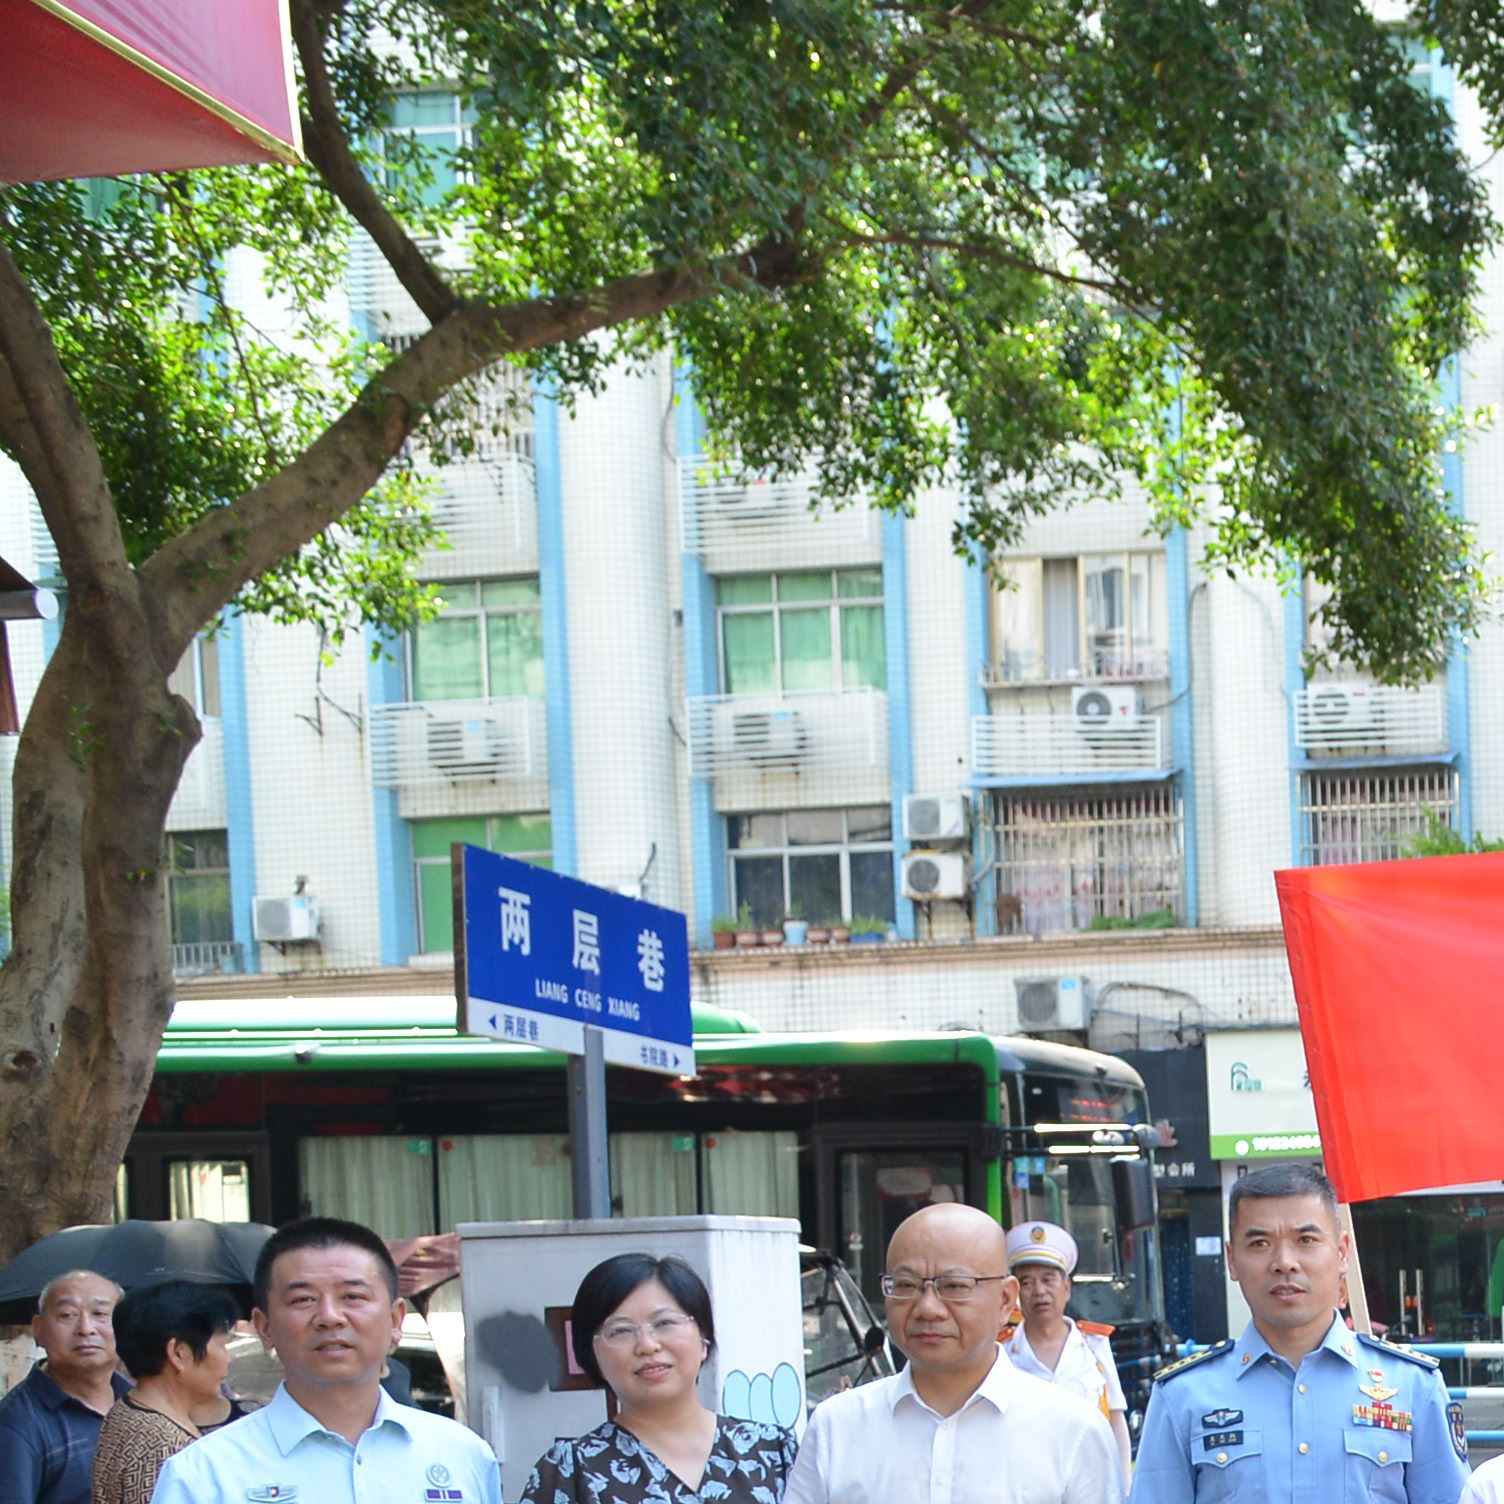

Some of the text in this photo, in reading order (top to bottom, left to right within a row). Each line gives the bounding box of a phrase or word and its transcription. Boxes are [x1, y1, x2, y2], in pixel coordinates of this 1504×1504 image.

[499, 885, 666, 993] 两层巷
[535, 978, 641, 1021] LIANG CENG XIANG
[503, 1014, 539, 1042] 两层巷
